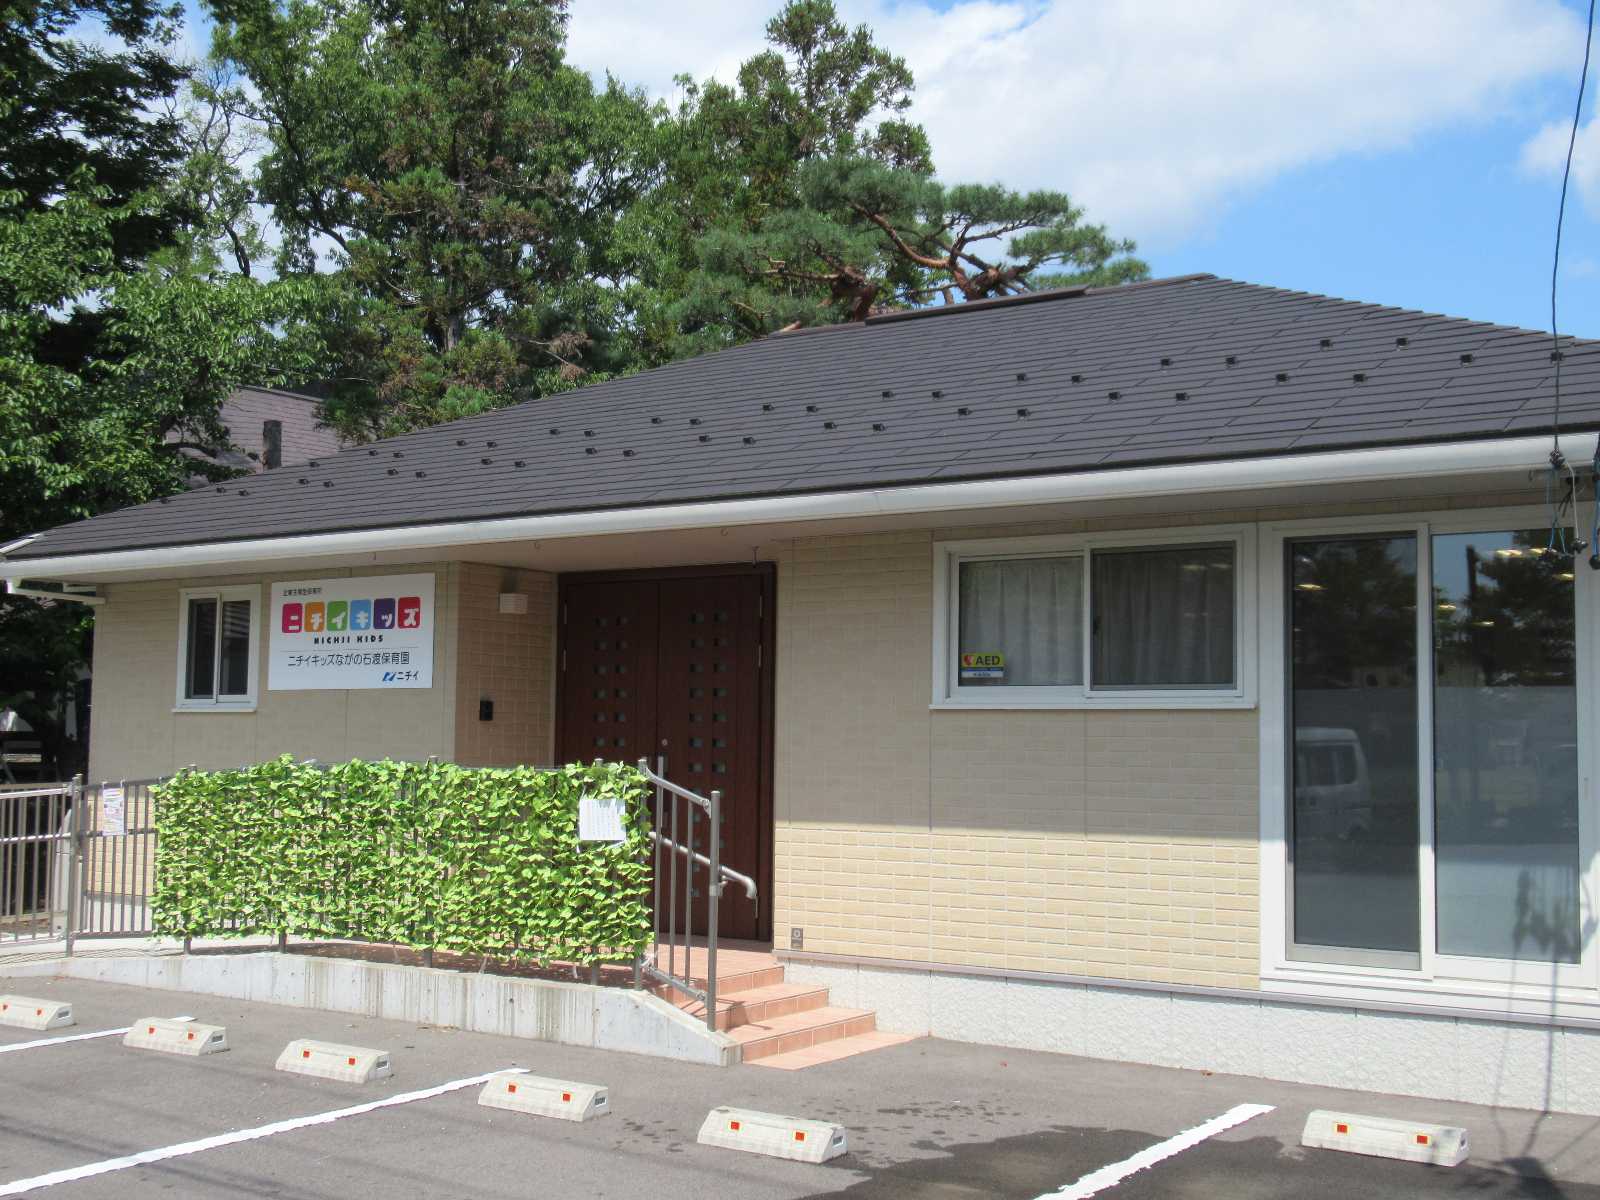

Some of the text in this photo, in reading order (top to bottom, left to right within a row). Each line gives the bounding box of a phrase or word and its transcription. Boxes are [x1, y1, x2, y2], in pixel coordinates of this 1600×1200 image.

[287, 607, 420, 631] ニチイキッズ
[356, 634, 384, 643] KIDS
[287, 651, 410, 667] ニチイキッズながの石渡保育園
[975, 655, 1001, 665] AED
[396, 670, 419, 681] ニチイ
